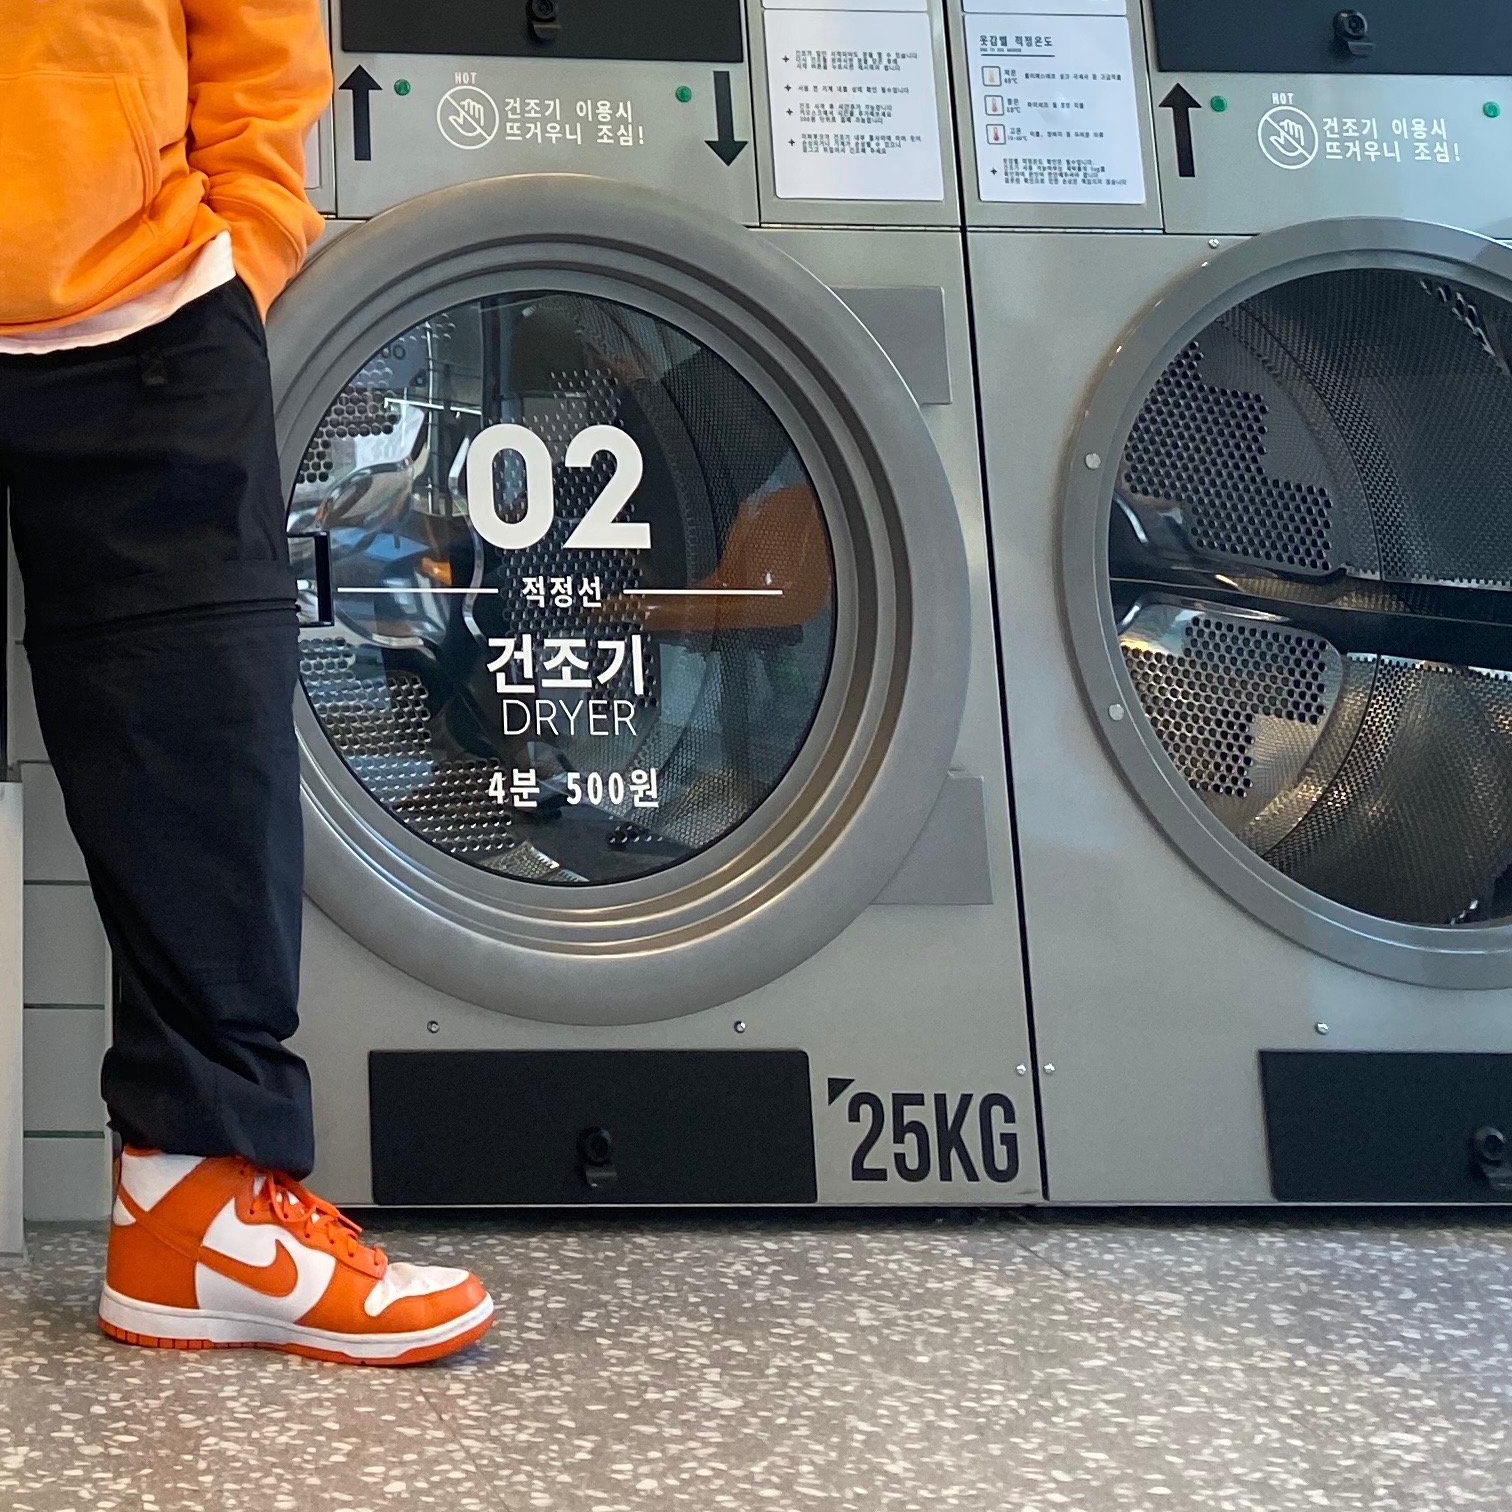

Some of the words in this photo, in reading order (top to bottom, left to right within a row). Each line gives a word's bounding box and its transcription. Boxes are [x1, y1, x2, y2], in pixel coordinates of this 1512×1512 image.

[454, 72, 477, 85] HOT
[504, 99, 561, 120] 건조기
[576, 99, 633, 123] 이용시
[1272, 92, 1294, 105] HOT
[505, 122, 582, 145] 뜨거우니
[596, 123, 645, 147] 조심!
[1322, 118, 1377, 139] 건조기
[1392, 118, 1447, 140] 이용시
[1325, 141, 1400, 163] 뜨거우니
[1414, 142, 1461, 164] 조심!
[468, 423, 651, 550] 02
[522, 576, 602, 608] 적정선
[487, 634, 645, 695] 건조기
[503, 700, 638, 737] DRYER
[488, 769, 540, 809] 4분
[566, 768, 659, 808] 500원
[848, 1092, 1020, 1183] 25KG
